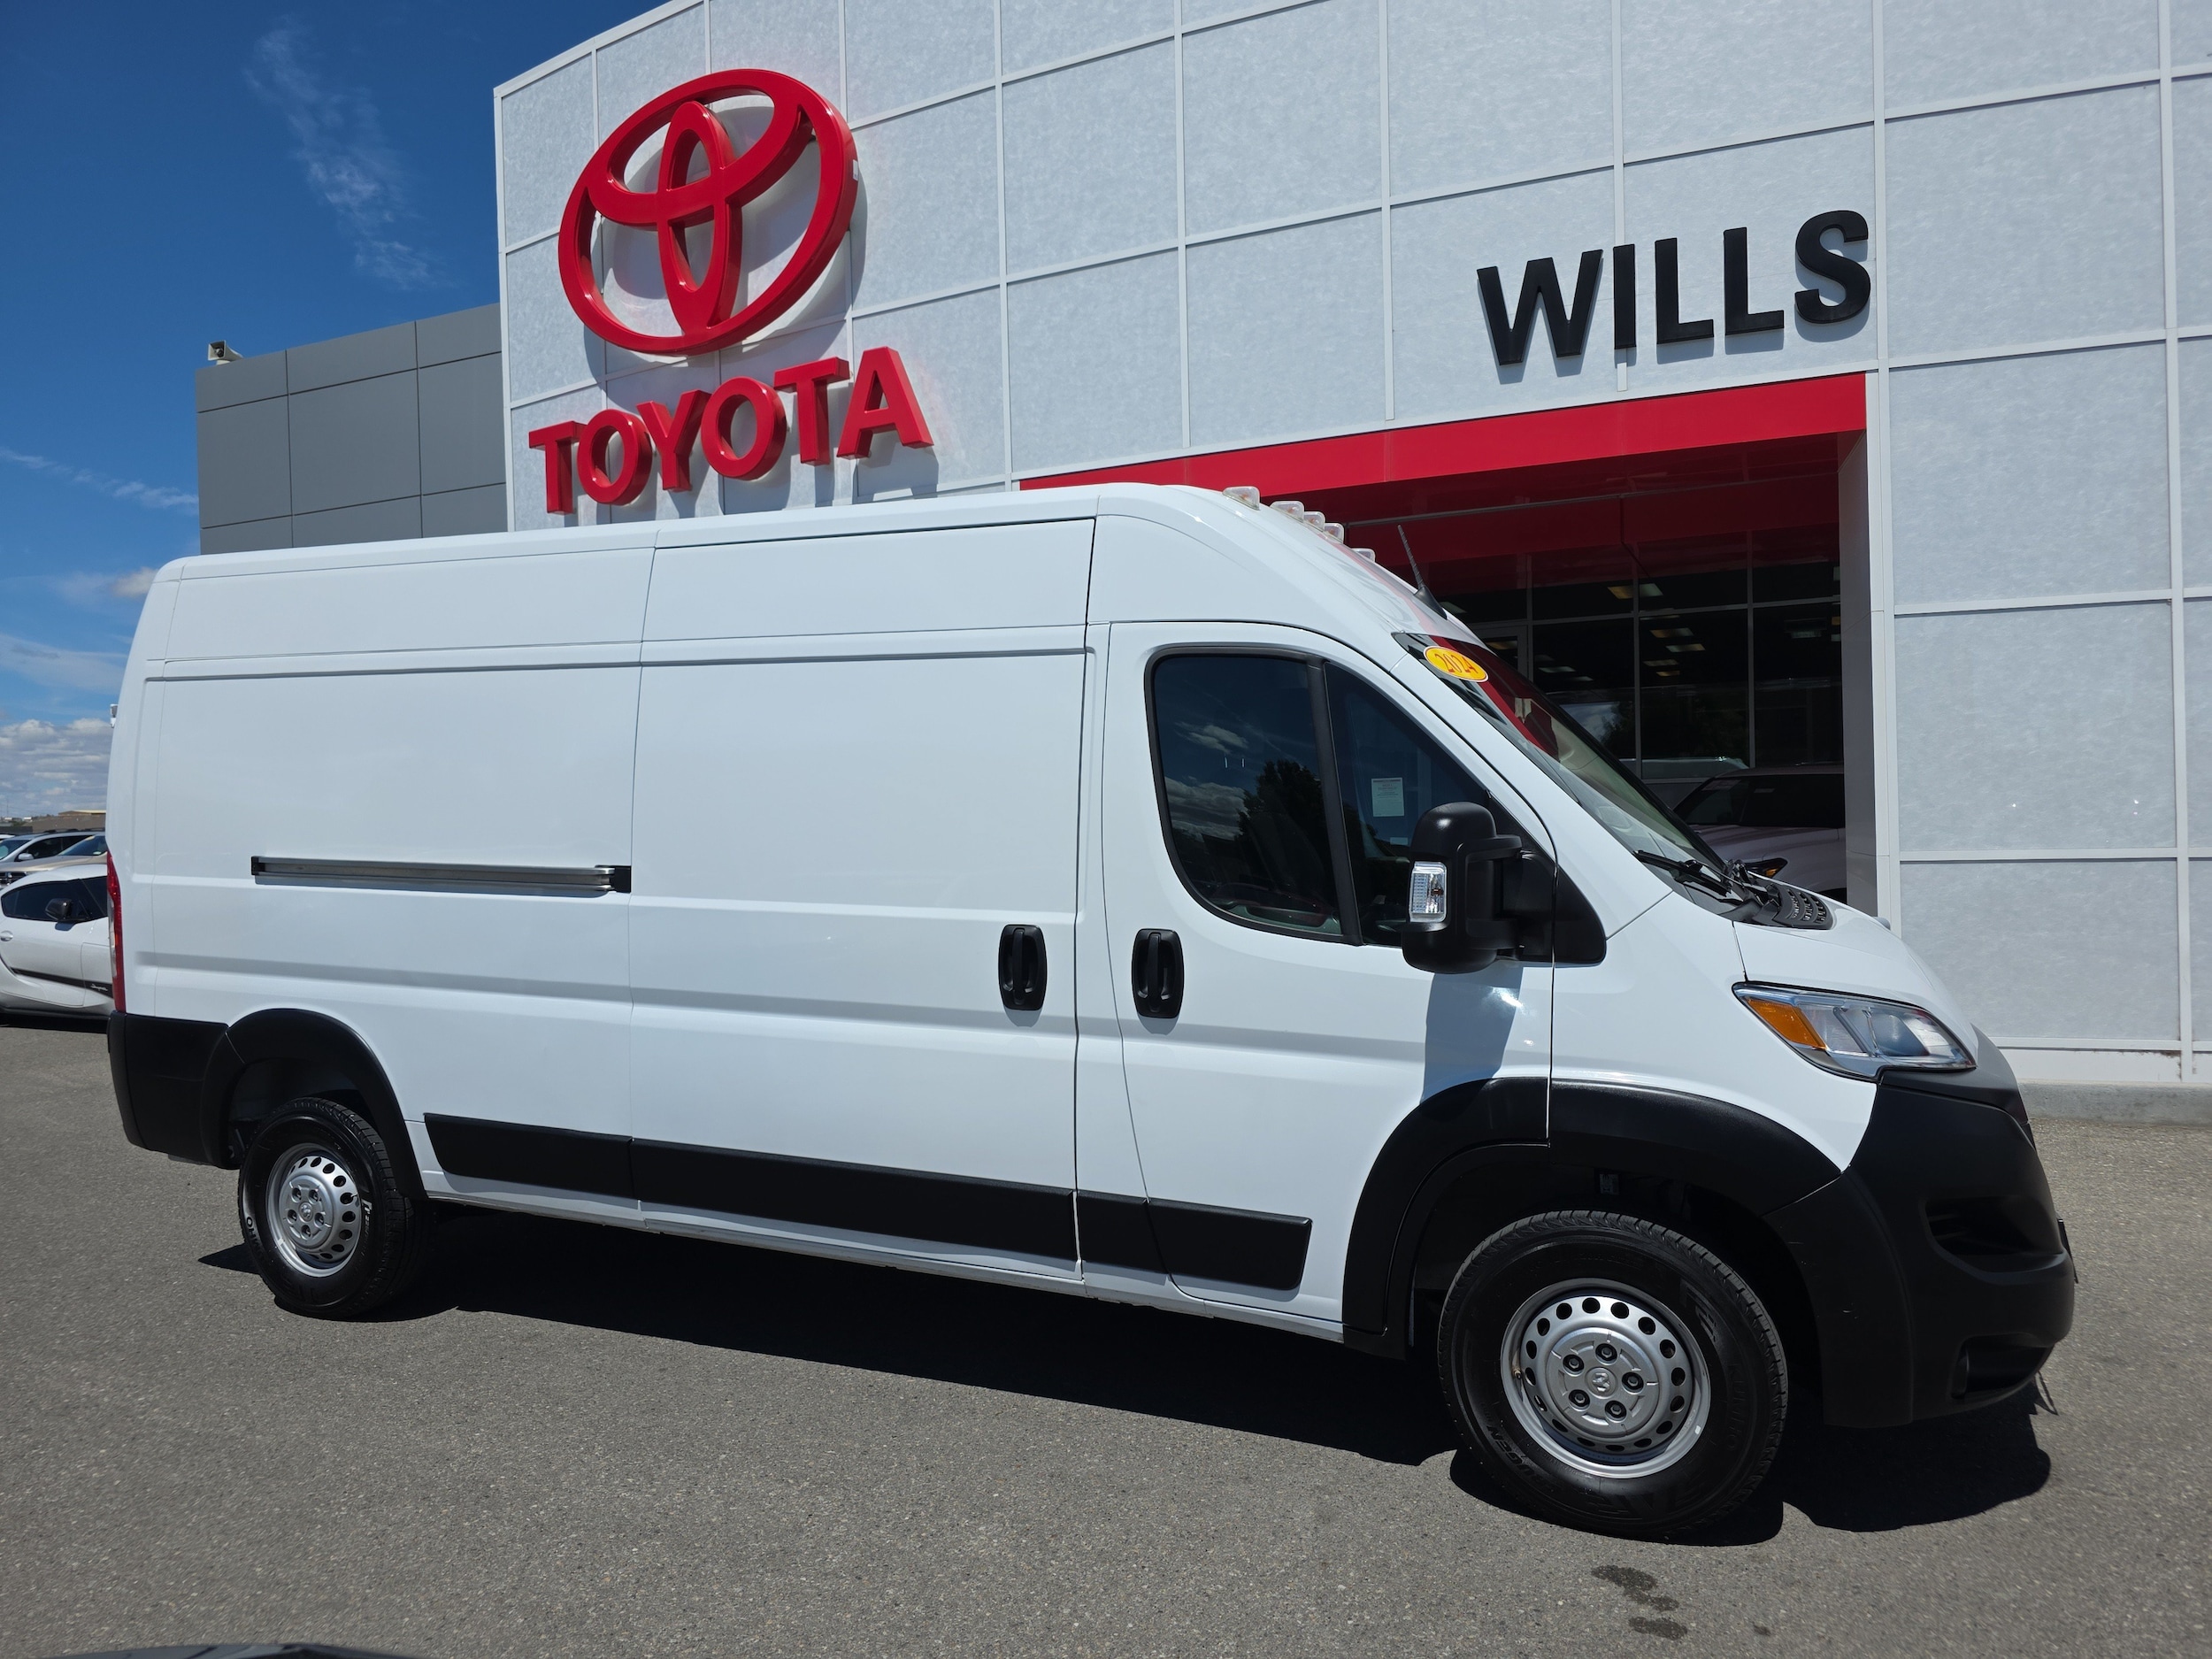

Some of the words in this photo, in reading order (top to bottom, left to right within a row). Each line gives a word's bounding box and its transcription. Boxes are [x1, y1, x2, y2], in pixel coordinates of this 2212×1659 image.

[1477, 210, 1871, 366] WILLS
[528, 346, 934, 514] TOYOTA
[1434, 653, 1479, 674] 2024
